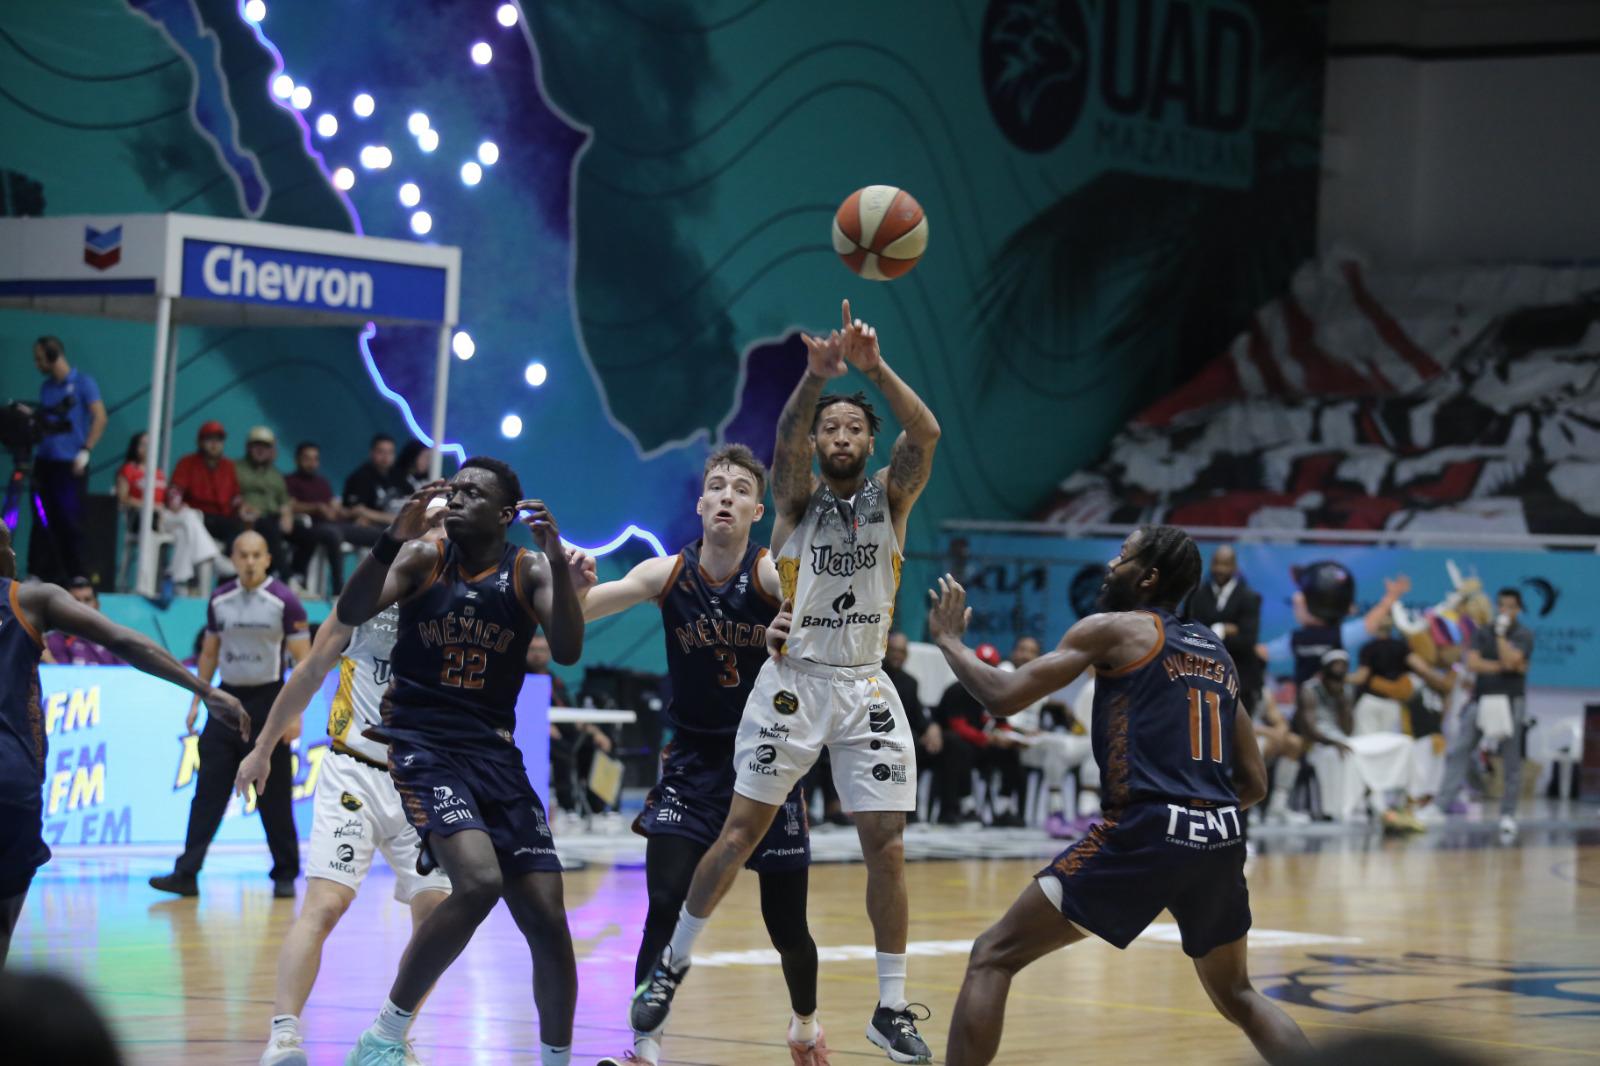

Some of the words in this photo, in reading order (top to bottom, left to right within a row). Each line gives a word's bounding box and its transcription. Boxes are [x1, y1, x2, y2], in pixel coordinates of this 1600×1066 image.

[202, 244, 374, 309] Chevron
[417, 611, 516, 655] MÉXICO
[674, 613, 769, 655] MÉXICO
[845, 612, 881, 625] zteca
[440, 645, 488, 689] 22
[713, 645, 741, 688] 3
[1162, 652, 1226, 684] HUGHES
[45, 685, 101, 736] FM
[1186, 687, 1223, 763] 11
[48, 762, 105, 815] FM
[747, 762, 778, 777] MEGA
[79, 805, 132, 846] FM
[433, 796, 467, 814] MEGA
[1166, 803, 1242, 843] TENT
[328, 861, 356, 876] MEGA
